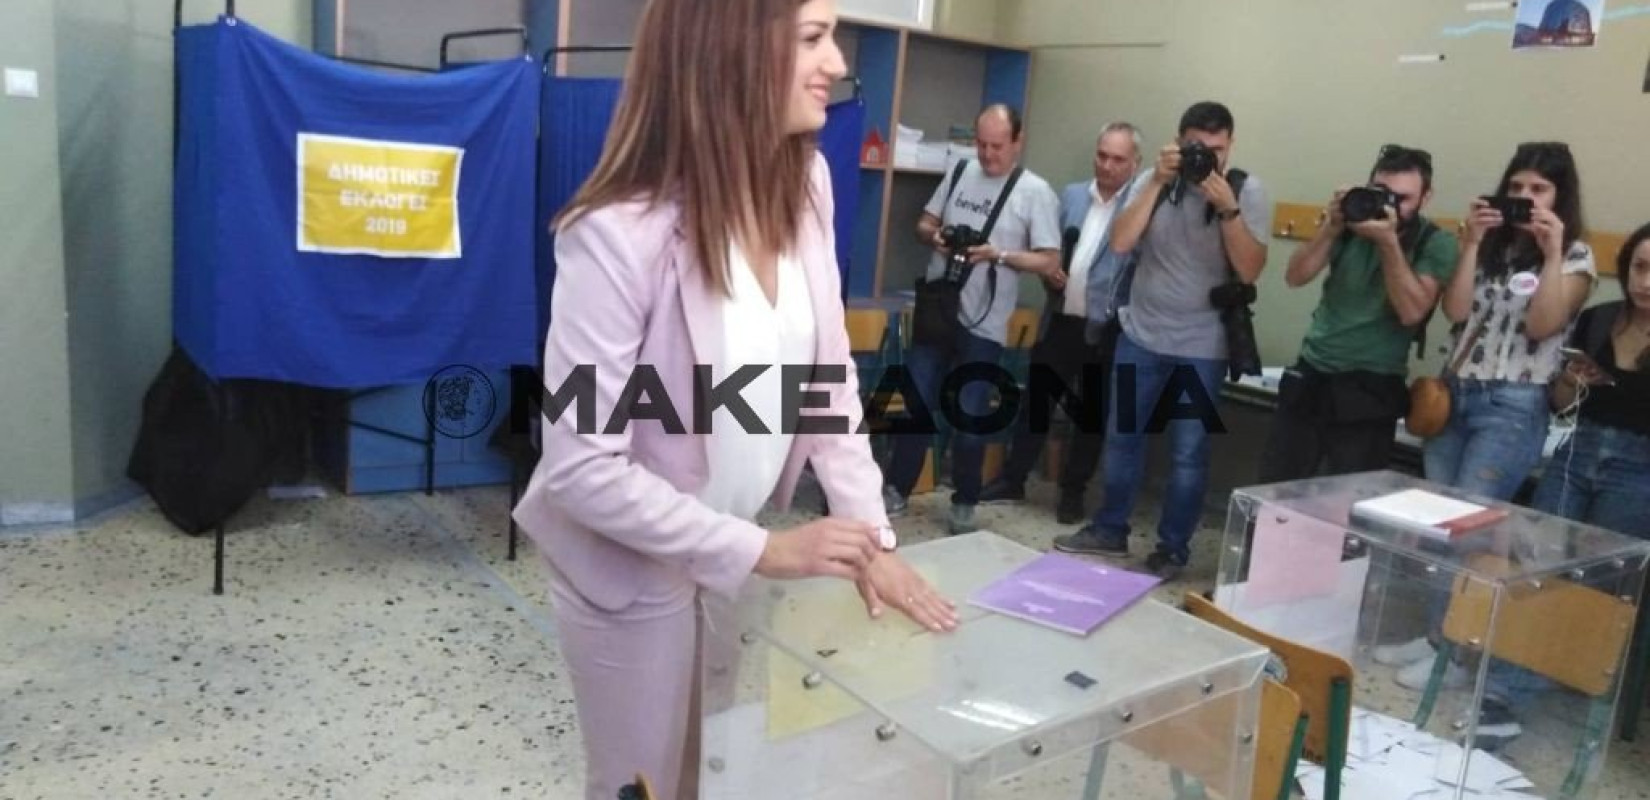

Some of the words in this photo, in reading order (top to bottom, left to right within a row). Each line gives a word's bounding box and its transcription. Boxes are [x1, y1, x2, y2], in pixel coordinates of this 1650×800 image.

[327, 162, 441, 187] ΔΗΜΟΤΙΚΕΣ
[340, 189, 427, 212] ΕΚΛΟΓΕΣ
[365, 217, 408, 236] 2019
